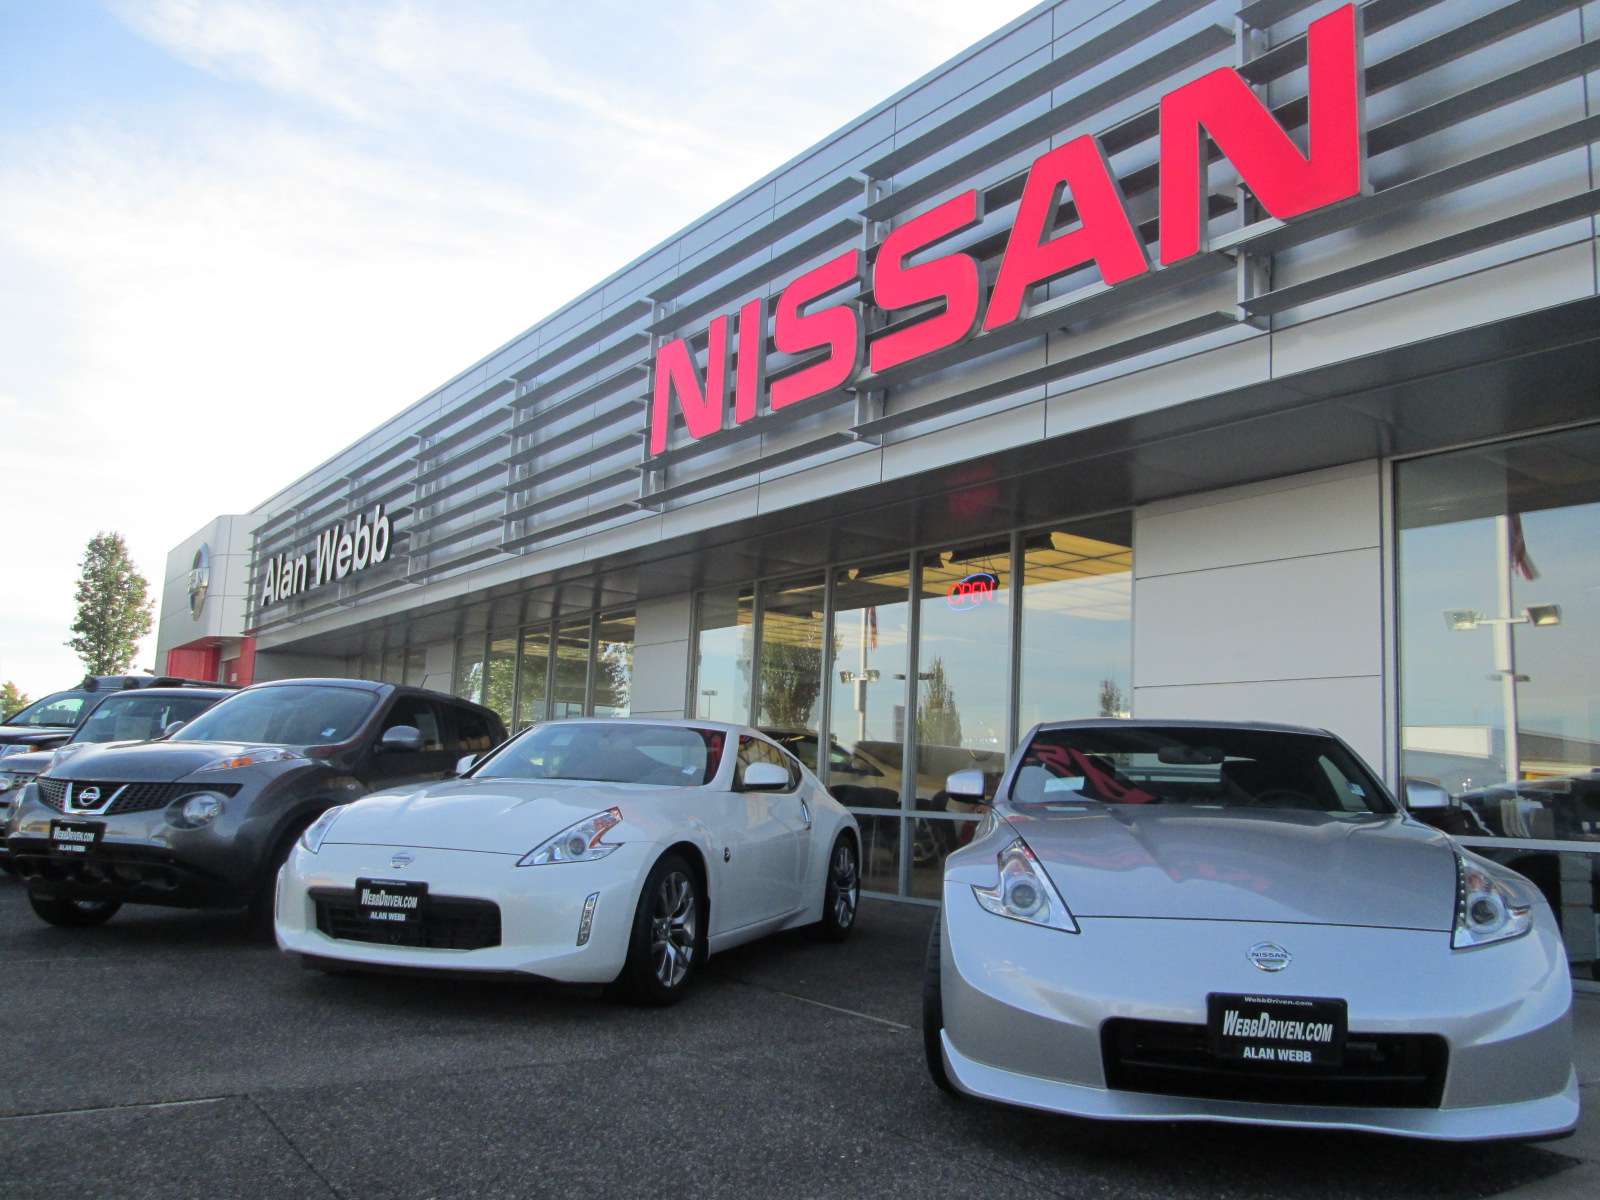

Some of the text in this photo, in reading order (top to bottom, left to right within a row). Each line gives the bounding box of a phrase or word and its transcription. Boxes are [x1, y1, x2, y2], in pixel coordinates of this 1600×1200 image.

[650, 2, 1362, 458] NISSAN
[261, 504, 390, 606] Alan Webb
[947, 579, 995, 605] OPEN
[370, 911, 406, 921] ALAN WEBB
[1244, 996, 1313, 1007] WebbDriven.com
[1243, 1046, 1312, 1063] ALAN WEBB
